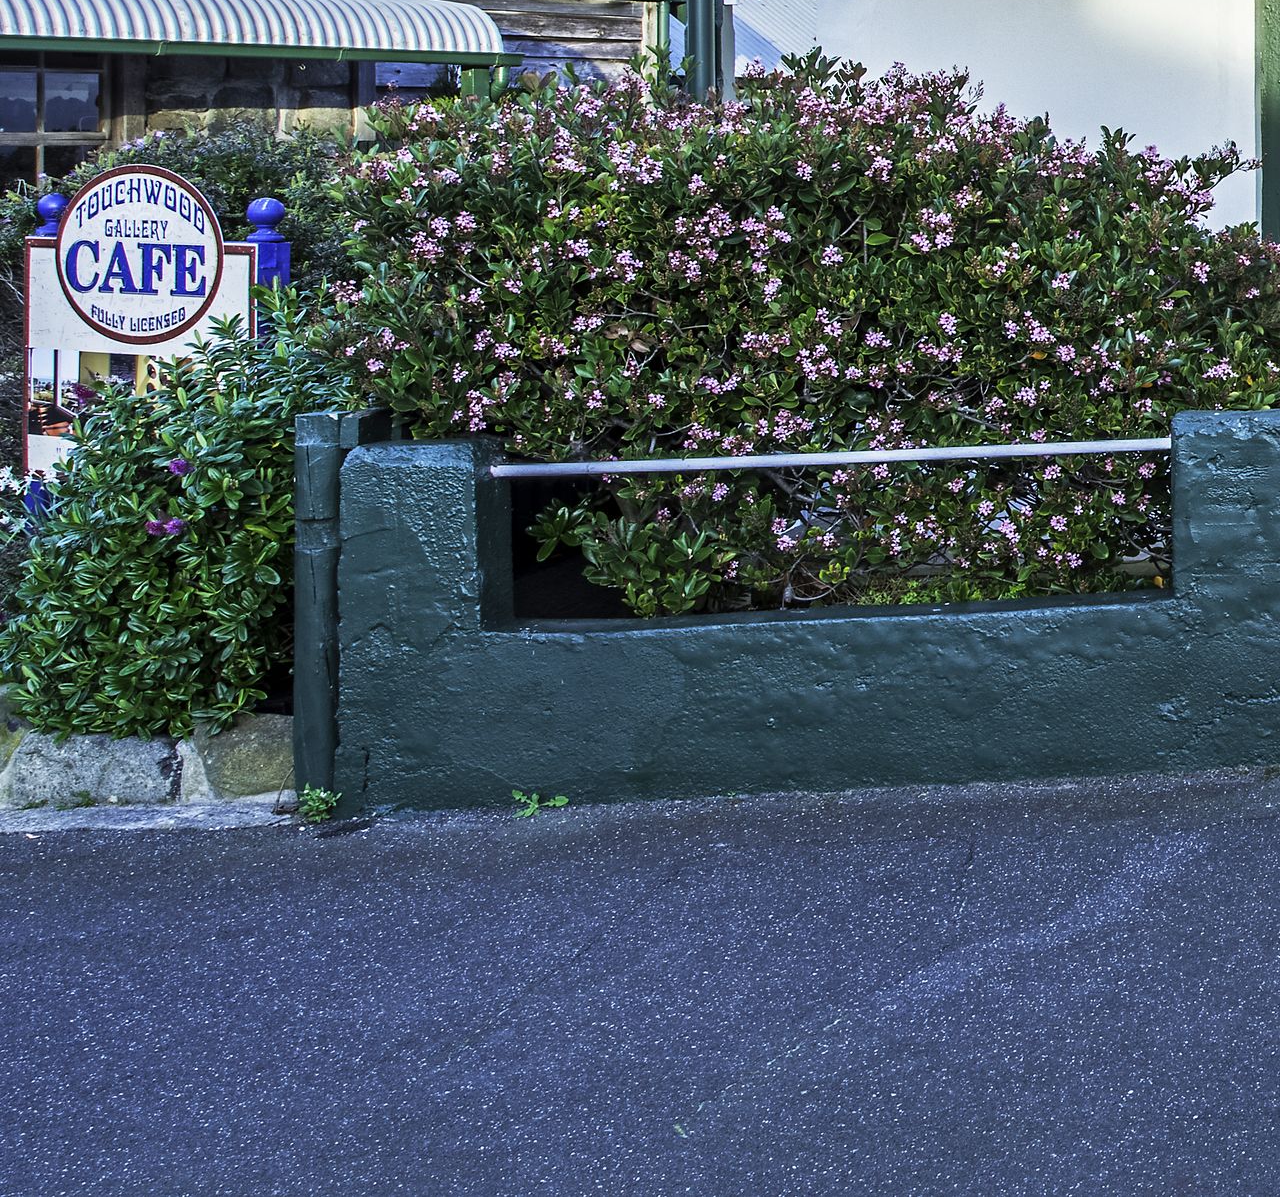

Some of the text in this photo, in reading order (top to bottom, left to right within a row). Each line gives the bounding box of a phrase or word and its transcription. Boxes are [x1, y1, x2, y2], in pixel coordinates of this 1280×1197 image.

[75, 178, 206, 235] TOUCHWOOD
[104, 218, 168, 241] GALLERY
[65, 239, 207, 298] CAFE
[91, 303, 186, 332] FULLY LICENSED
